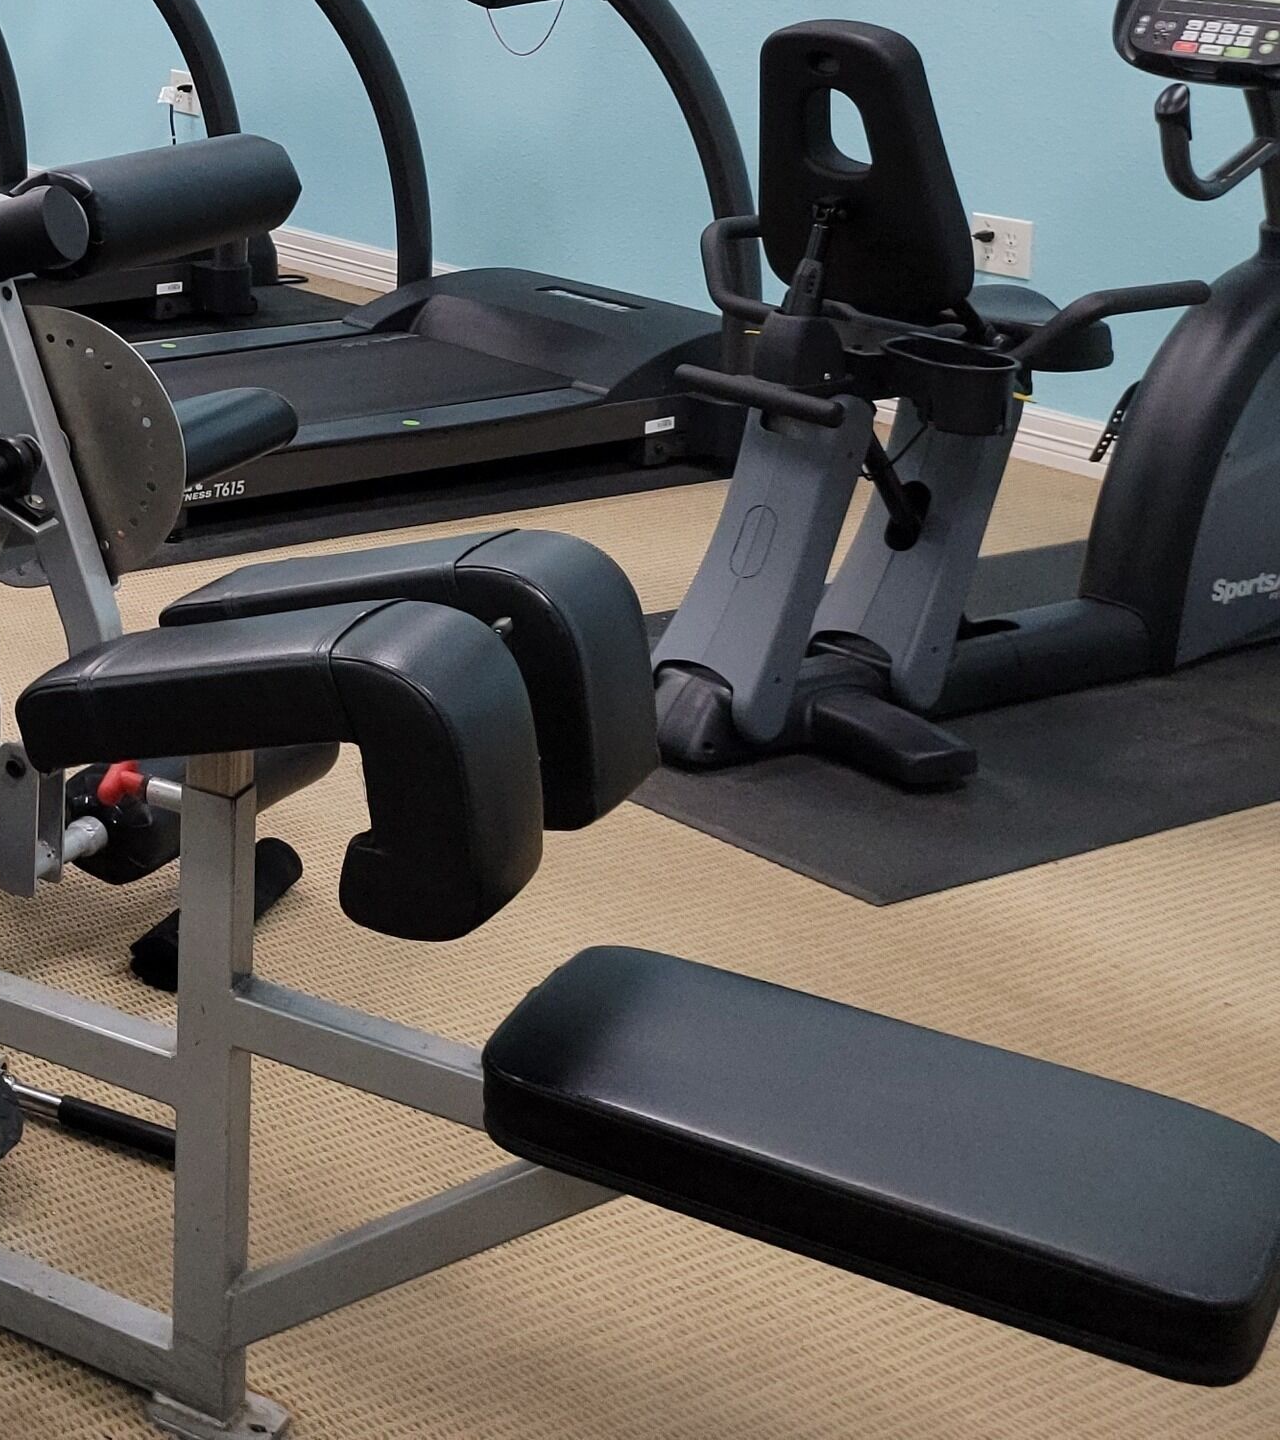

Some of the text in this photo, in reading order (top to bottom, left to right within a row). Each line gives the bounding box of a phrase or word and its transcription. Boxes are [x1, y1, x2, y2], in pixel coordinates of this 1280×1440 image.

[184, 479, 246, 502] NESS T615
[1211, 572, 1280, 605] Sports
